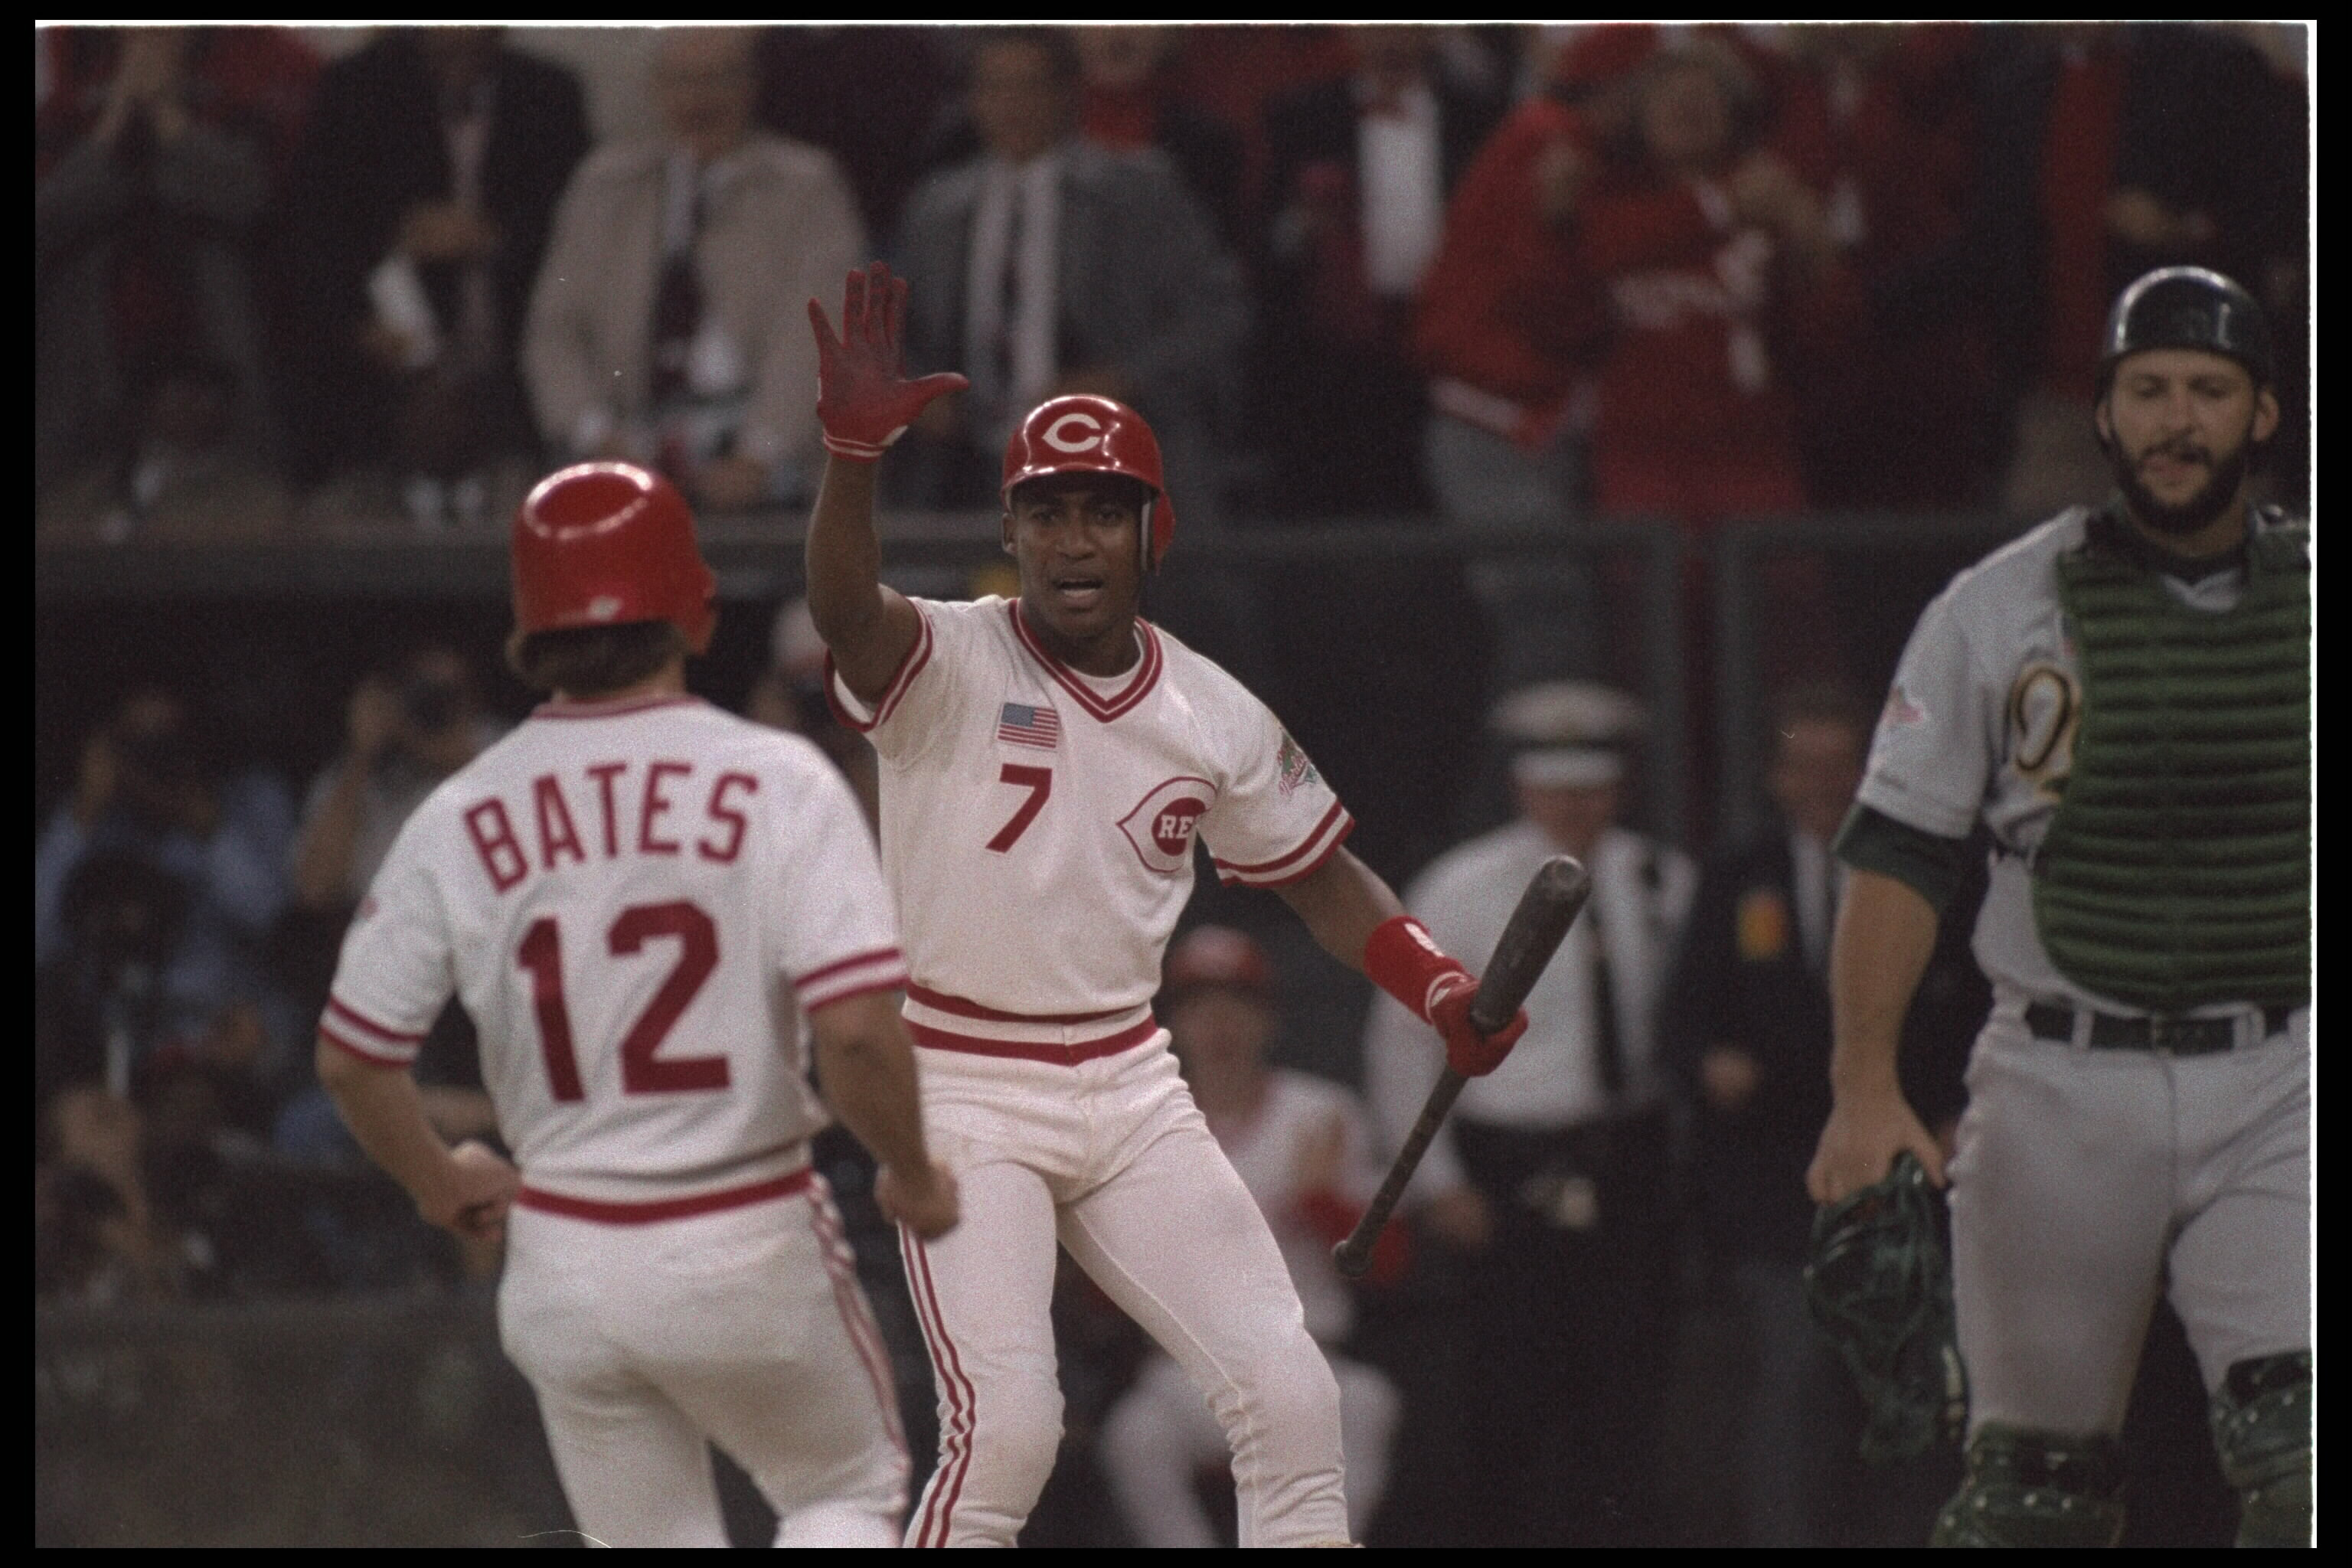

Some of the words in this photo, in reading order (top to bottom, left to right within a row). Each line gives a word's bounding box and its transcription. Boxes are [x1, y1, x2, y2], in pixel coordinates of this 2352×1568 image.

[1041, 413, 1102, 453] C
[464, 761, 760, 894] BATES
[985, 763, 1053, 854] 7
[515, 898, 732, 1104] 12
